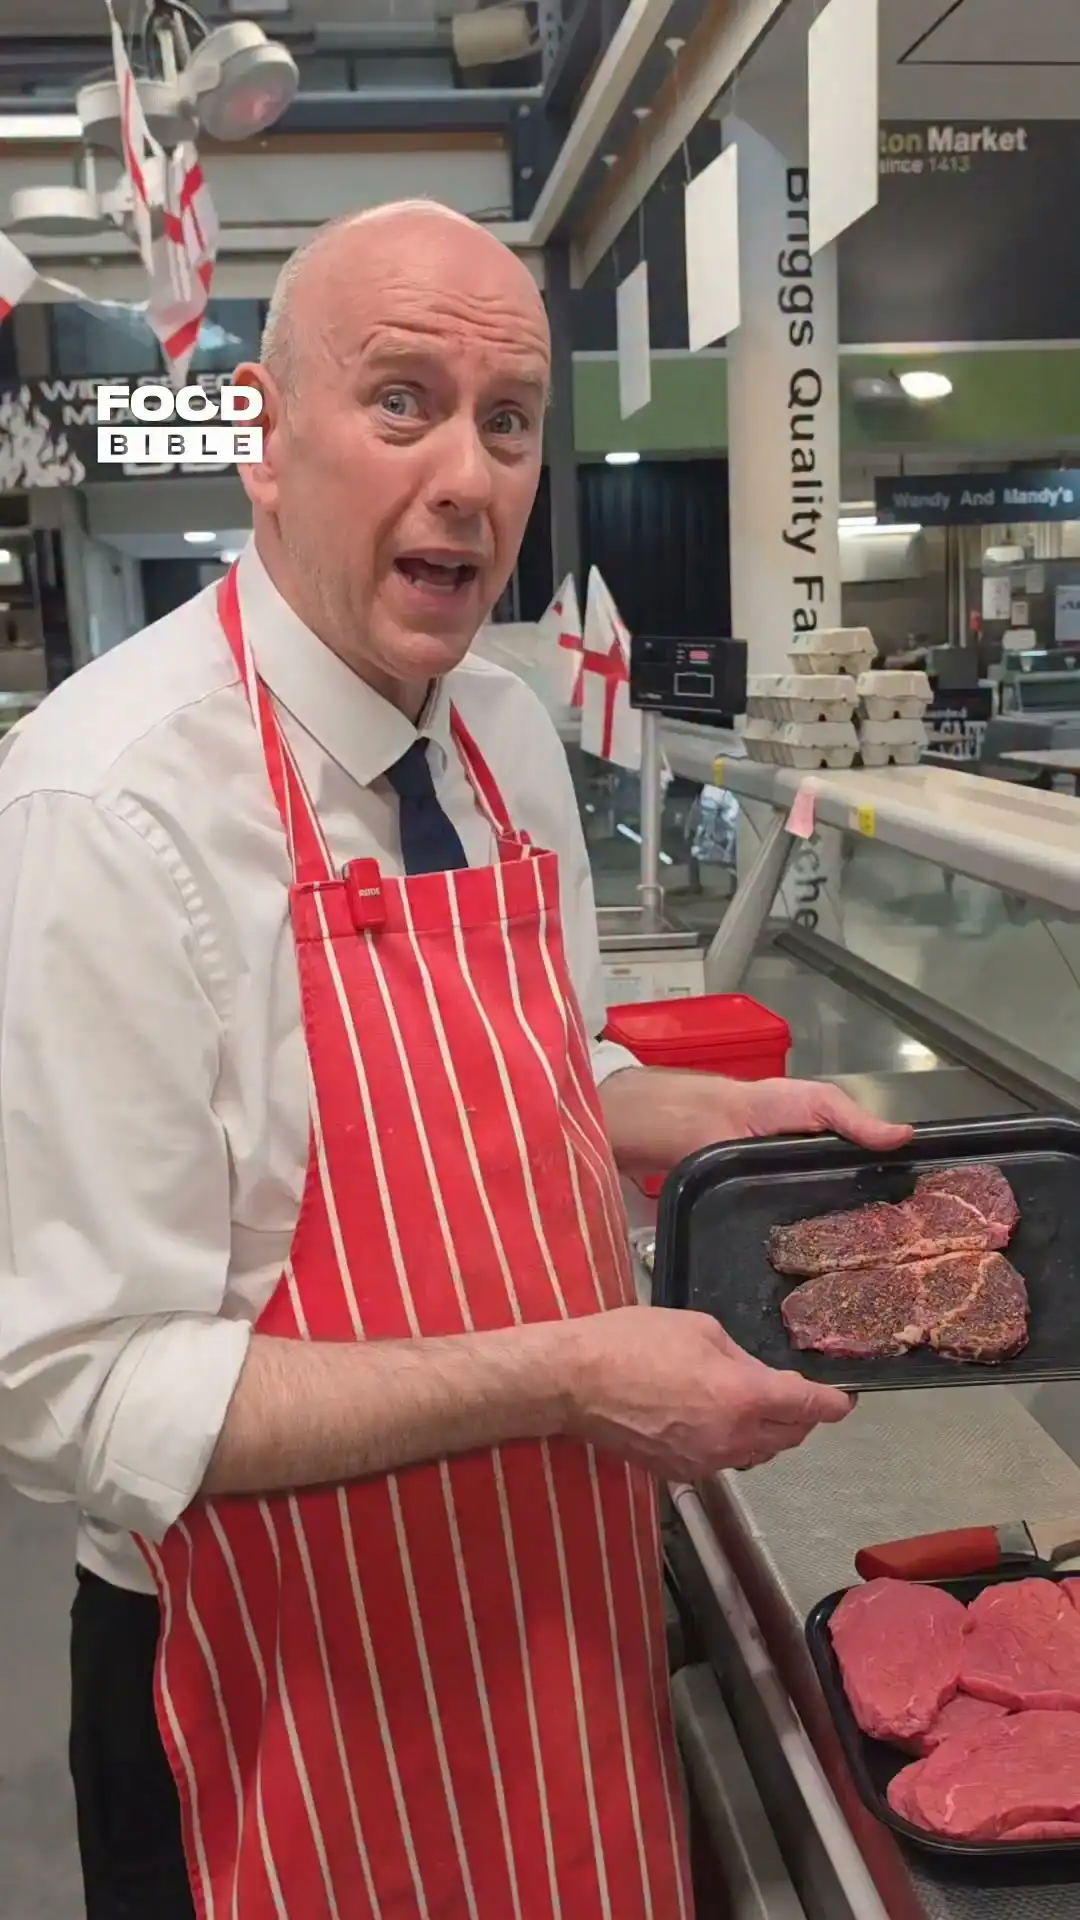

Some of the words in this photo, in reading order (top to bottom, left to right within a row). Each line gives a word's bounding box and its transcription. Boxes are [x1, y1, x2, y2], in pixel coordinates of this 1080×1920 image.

[928, 125, 1028, 152] Market
[928, 155, 971, 172] 1413
[778, 167, 814, 348] Briggs
[782, 367, 823, 555] Quality
[960, 488, 996, 506] And
